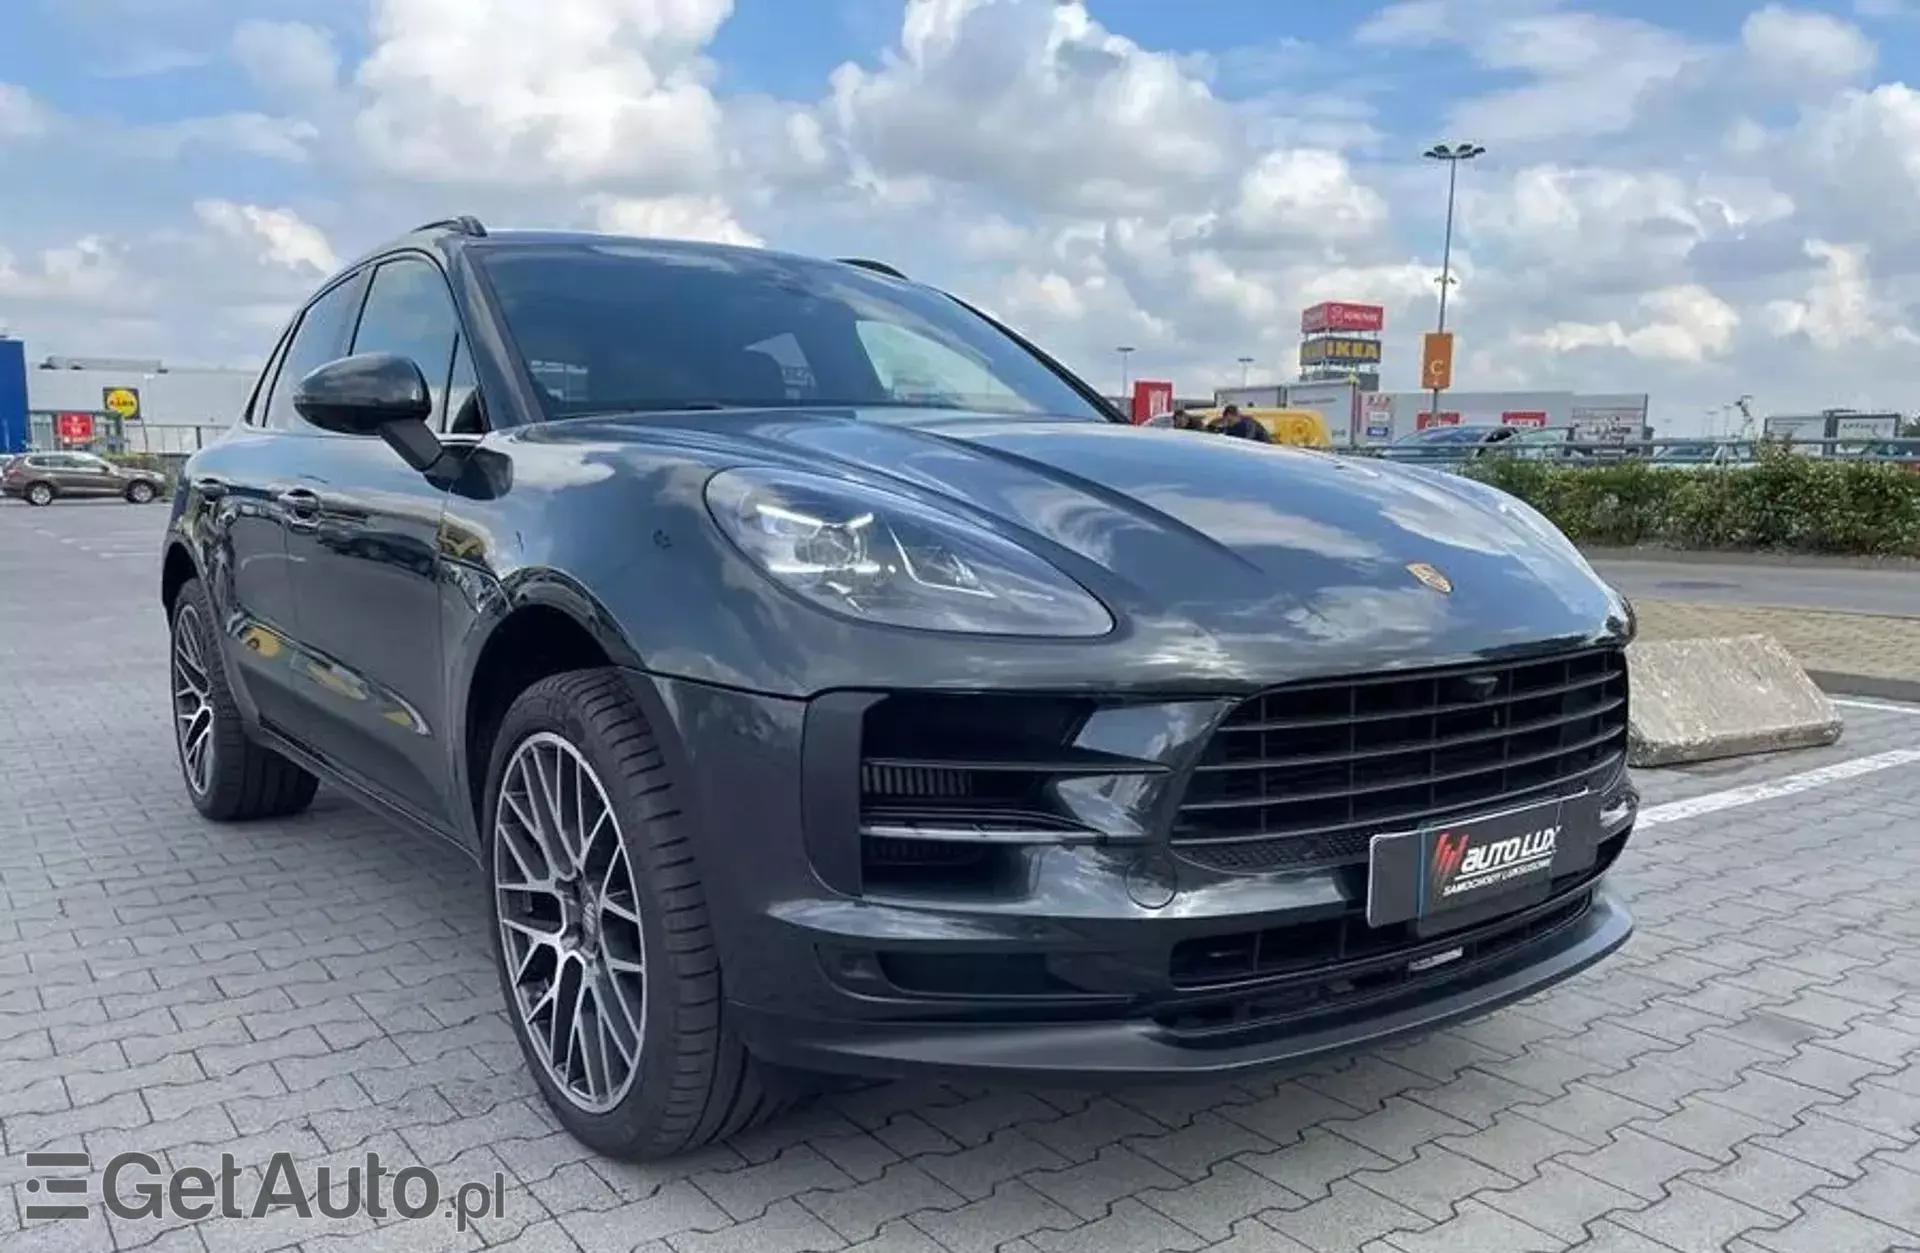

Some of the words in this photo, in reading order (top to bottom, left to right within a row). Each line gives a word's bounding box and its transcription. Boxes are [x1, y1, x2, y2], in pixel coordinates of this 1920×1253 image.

[1325, 341, 1379, 358] IKEA
[1430, 359, 1444, 376] C
[1521, 825, 1562, 856] LUX
